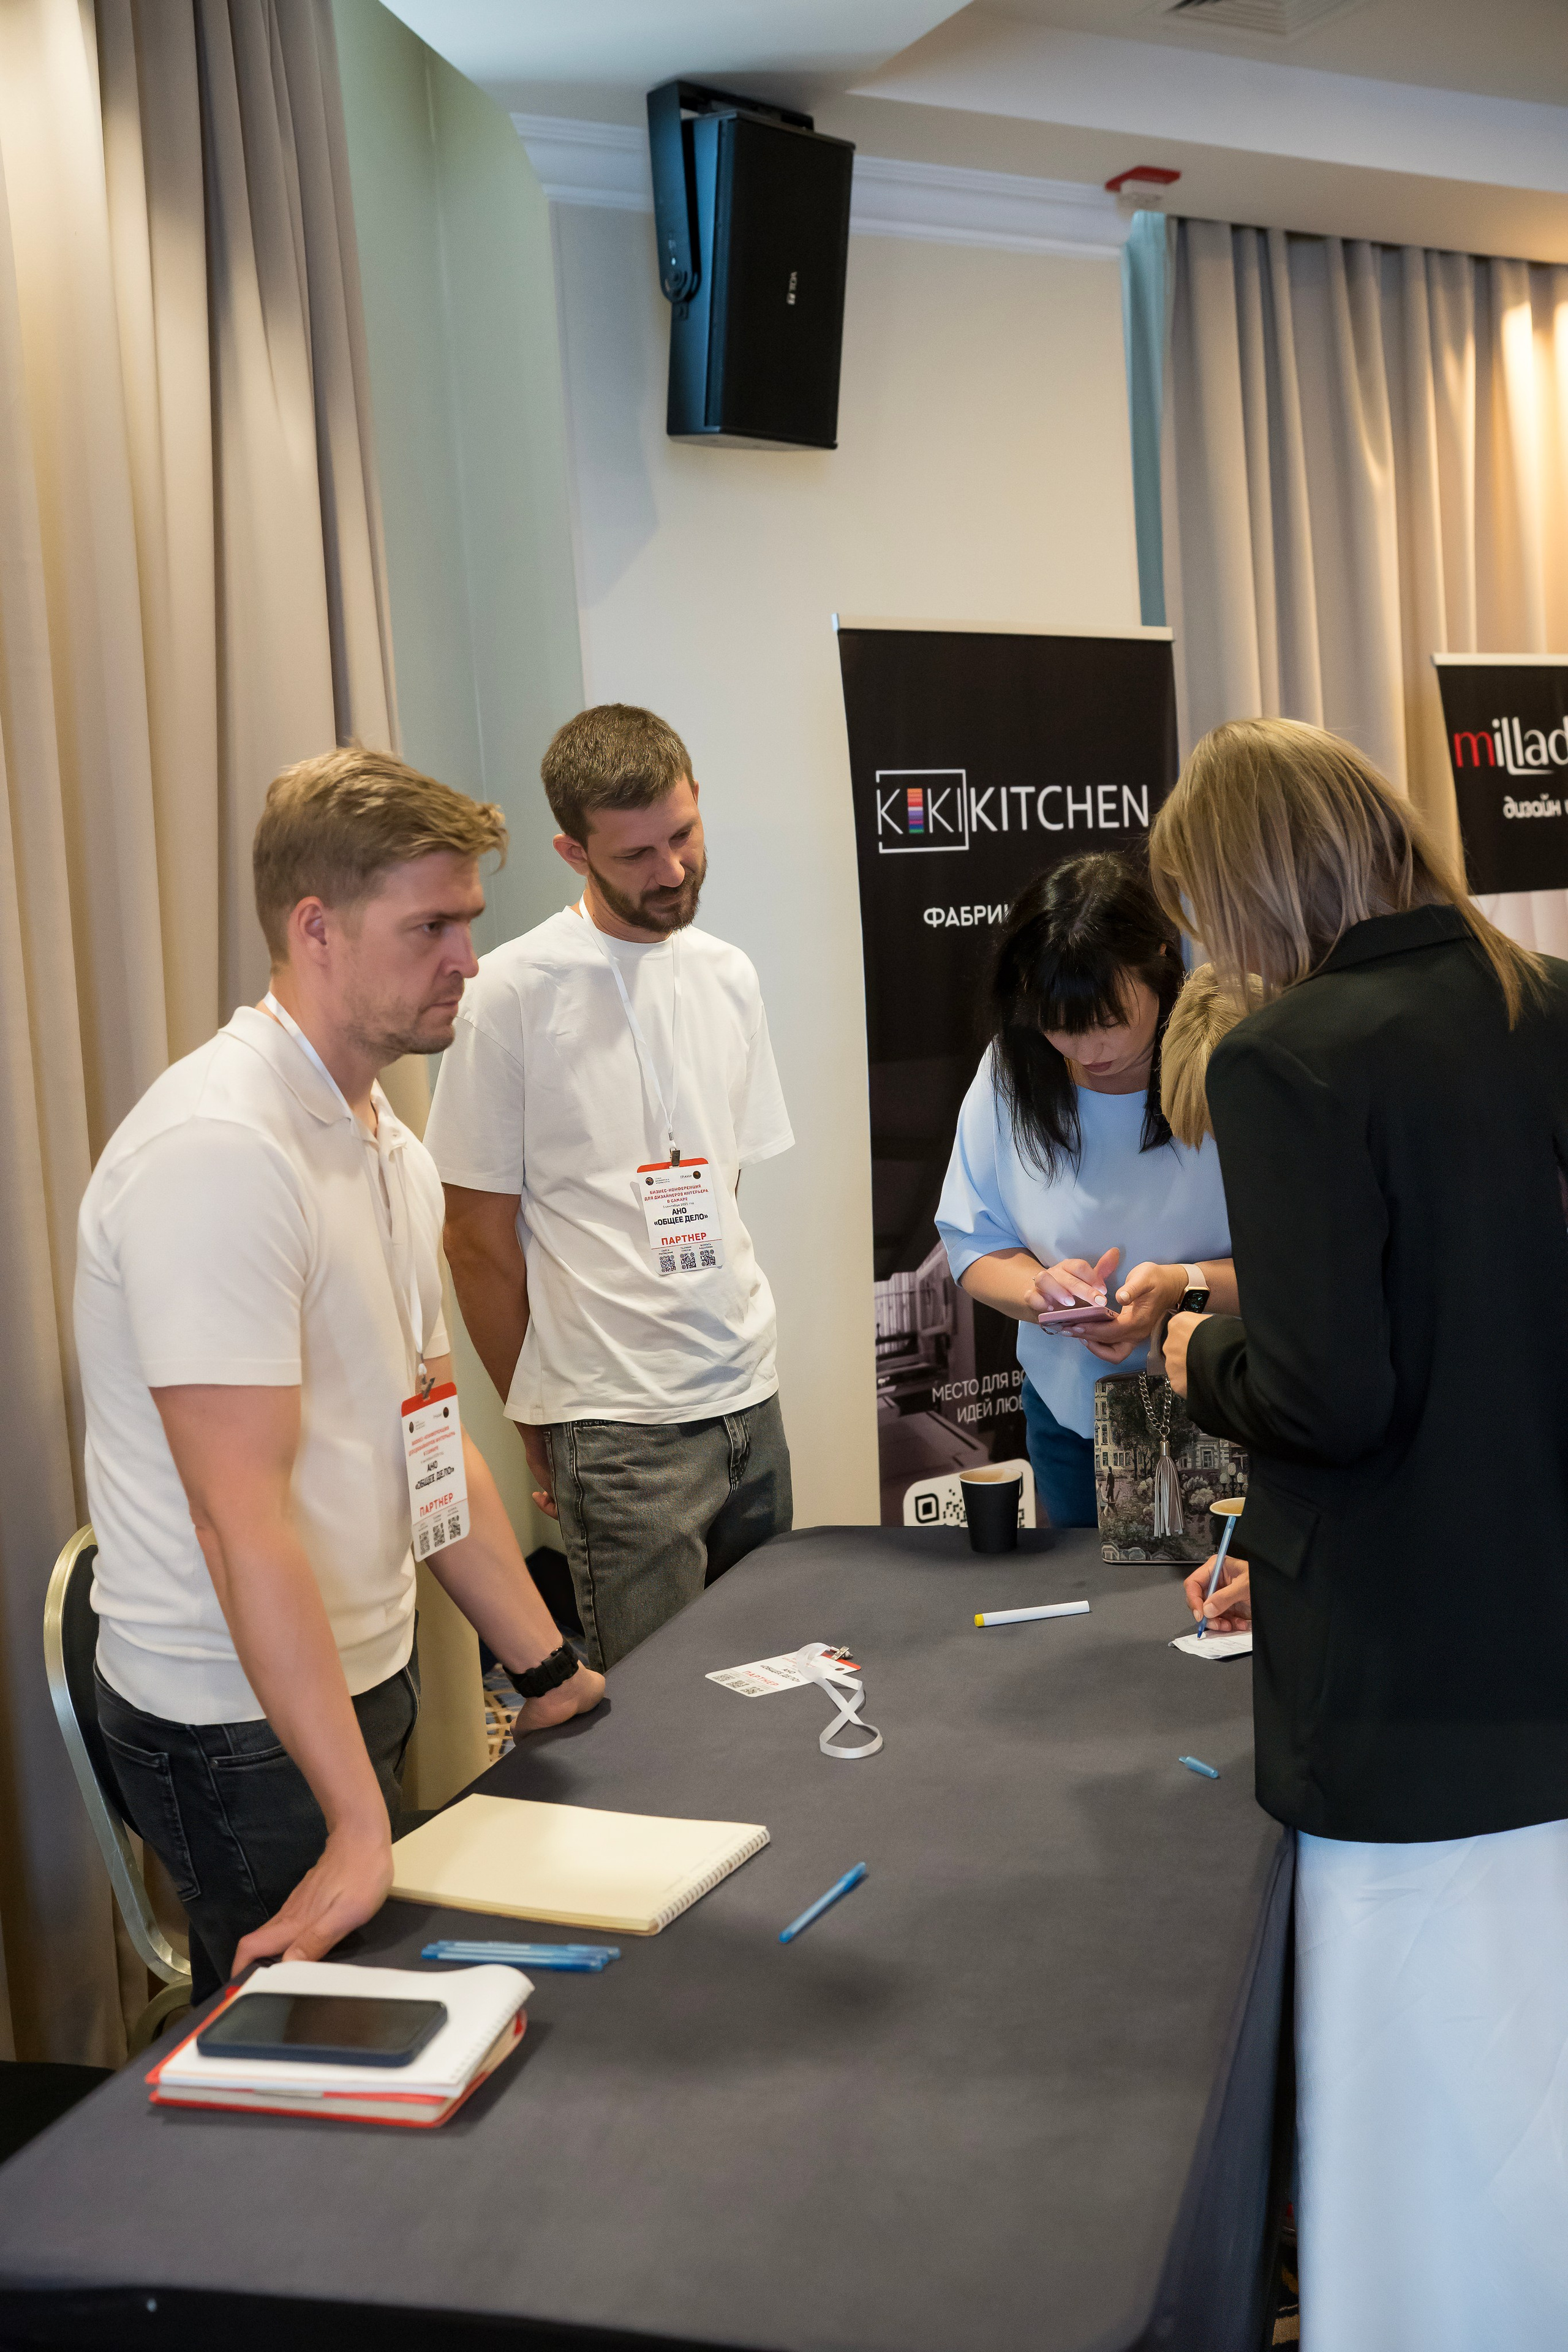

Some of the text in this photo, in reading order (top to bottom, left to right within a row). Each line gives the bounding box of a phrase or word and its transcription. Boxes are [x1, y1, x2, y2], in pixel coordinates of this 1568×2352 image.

[970, 784, 1149, 832] KITCHEN
[654, 1213, 708, 1226] «ОБЩЕЕ ДЕЛО»
[661, 1232, 707, 1246] ПАРТНЕР
[932, 1379, 980, 1403] МЕСТО
[981, 1372, 1009, 1395] ДЛЯ
[957, 1398, 993, 1424] ИДЕЙ
[420, 1493, 453, 1517] ПАРТНЕР
[742, 1670, 780, 1686] ПАРТНЕР
